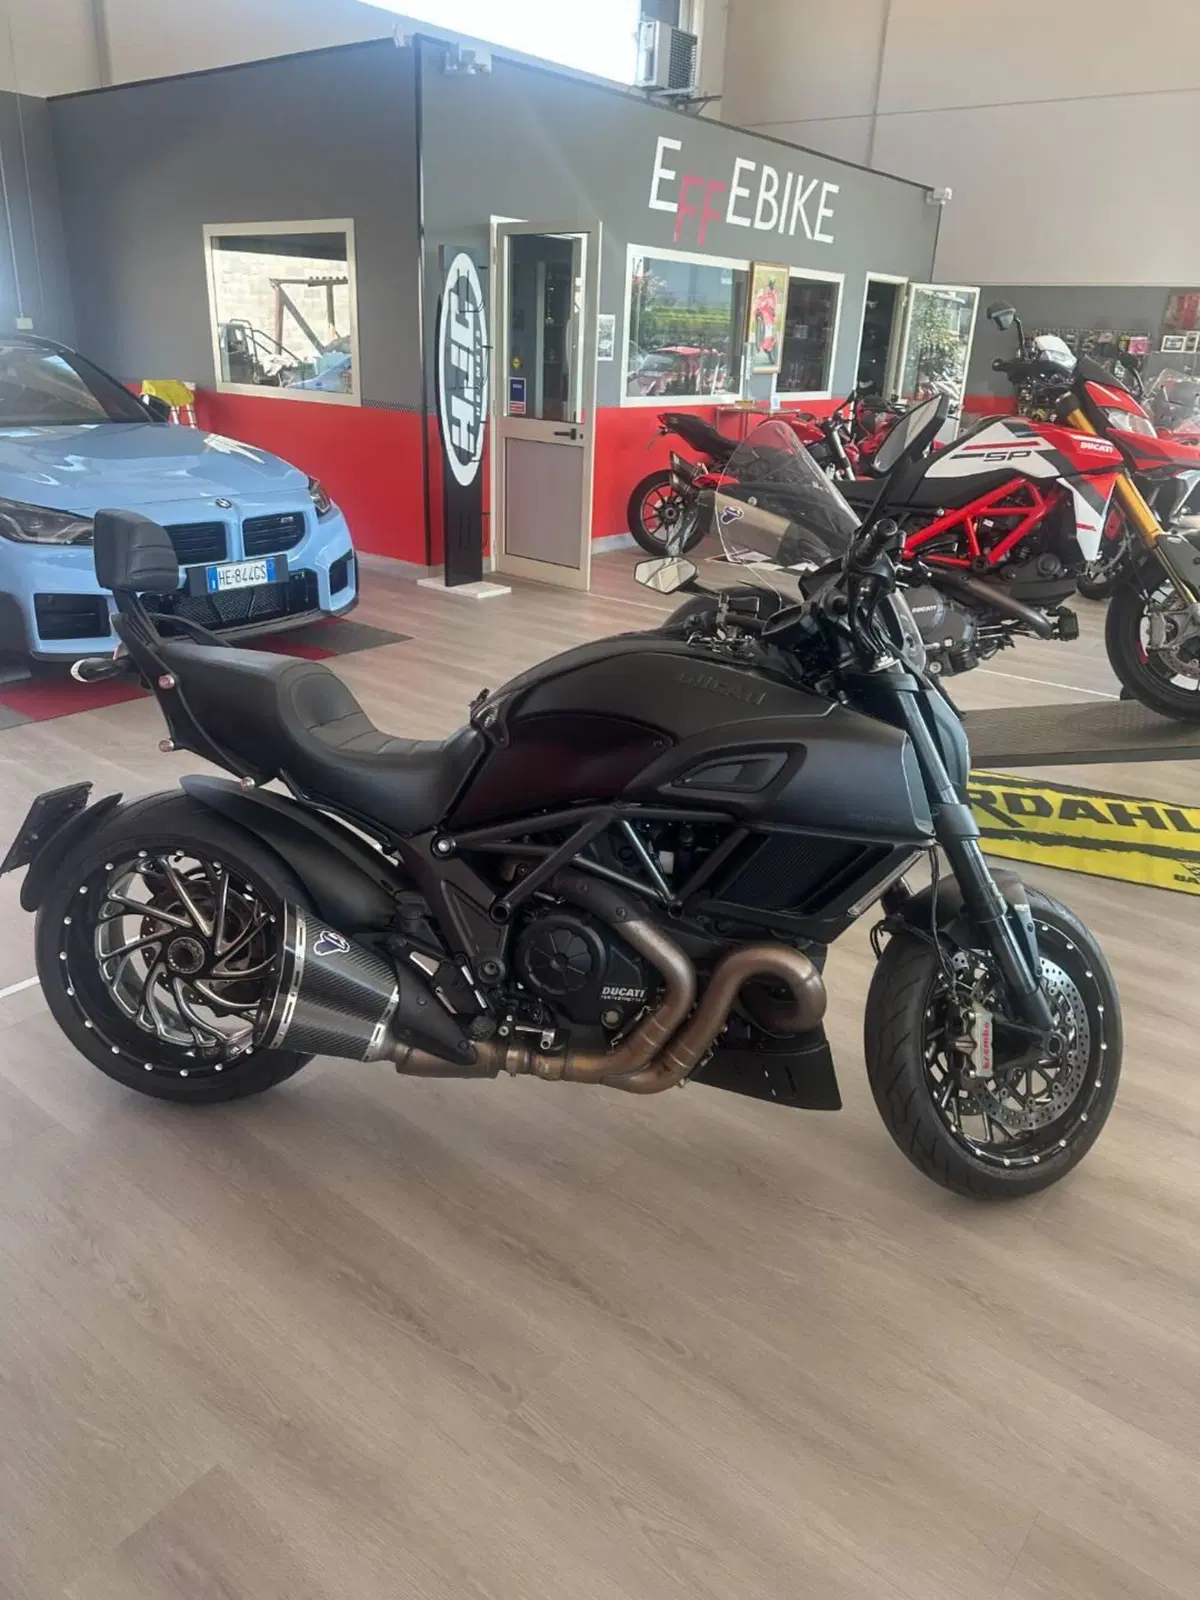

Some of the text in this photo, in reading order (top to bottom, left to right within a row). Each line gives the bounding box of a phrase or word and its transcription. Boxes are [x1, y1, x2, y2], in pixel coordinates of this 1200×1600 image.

[648, 136, 840, 248] EFFEBIKE
[450, 290, 475, 454] HJC
[983, 451, 1032, 462] SP
[1080, 441, 1114, 453] DUCATI
[602, 986, 645, 998] DUCATI
[982, 1021, 990, 1071] brembo
